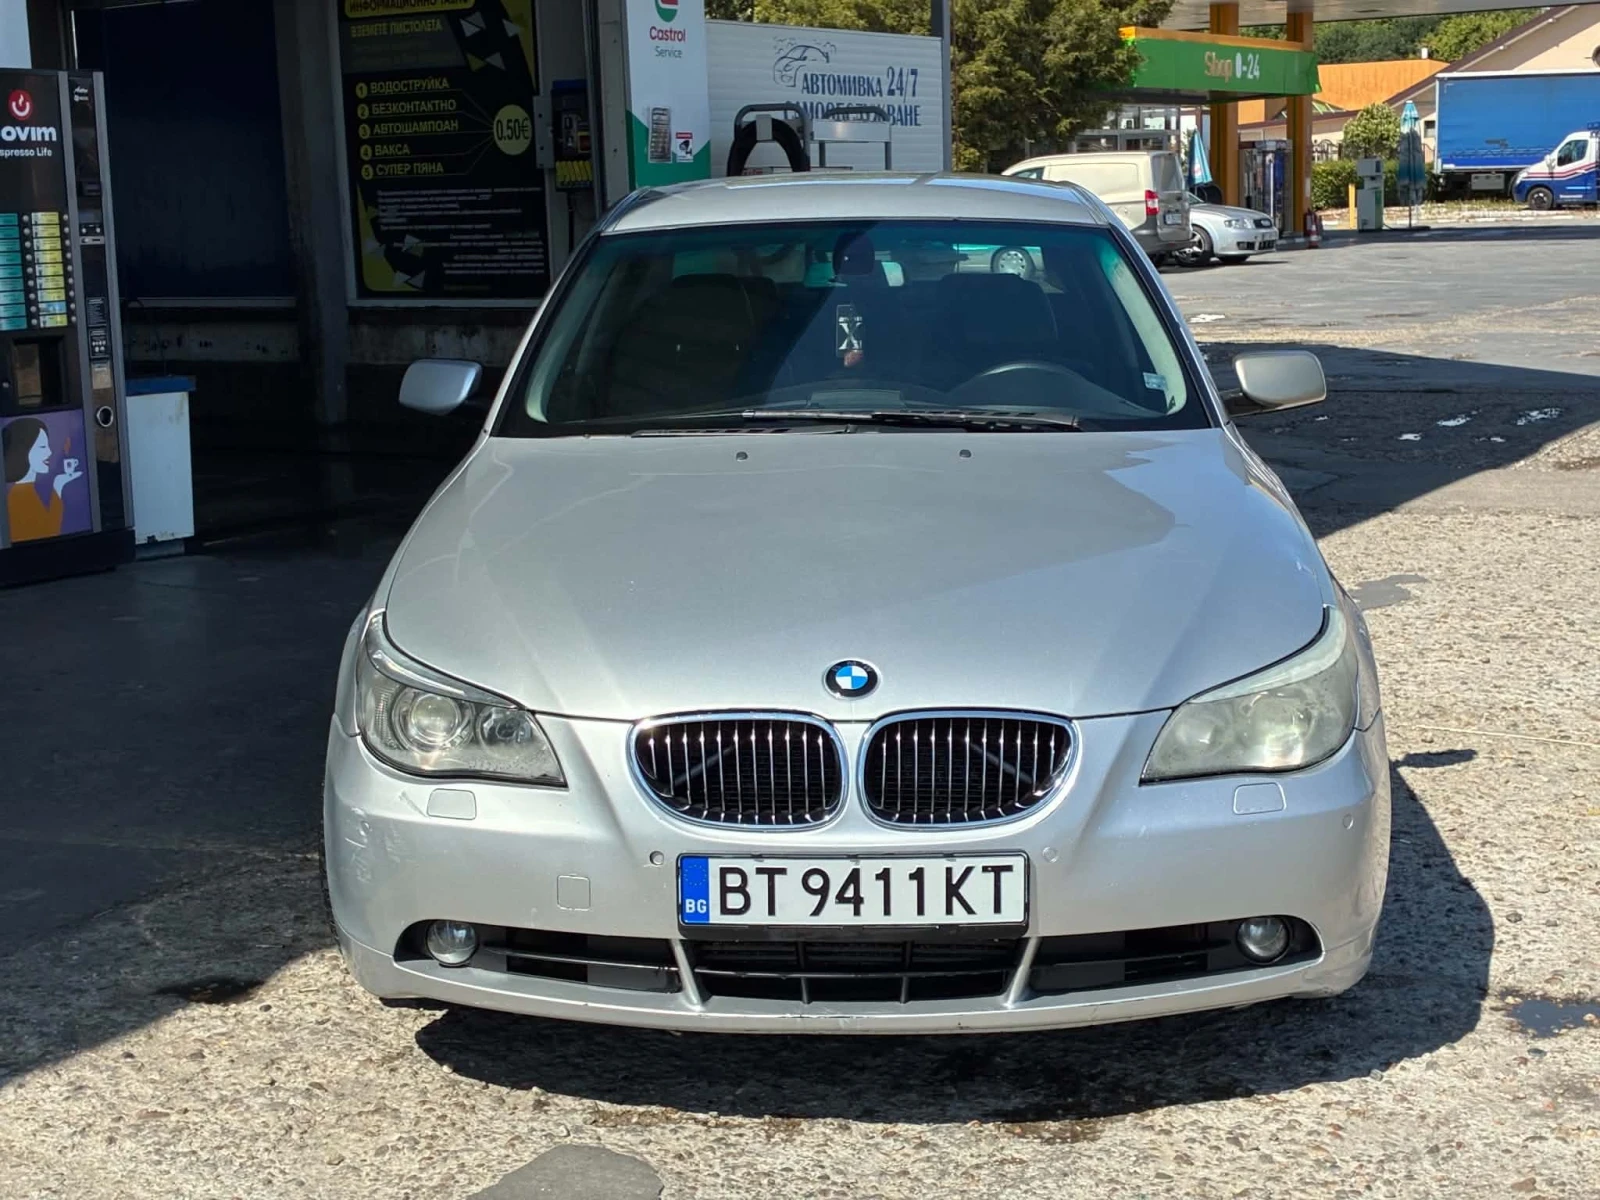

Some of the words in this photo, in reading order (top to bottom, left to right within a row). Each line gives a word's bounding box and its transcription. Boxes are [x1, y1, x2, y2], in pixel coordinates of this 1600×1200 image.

[390, 20, 443, 35] ПИСТОЛЕТА
[649, 26, 686, 43] Castrol
[654, 45, 684, 58] Service
[1204, 51, 1232, 84] Shop
[1235, 52, 1260, 79] 0-24
[370, 77, 450, 95] ВОДОСТРУЙКА
[802, 73, 883, 97] АВТОМИВКА
[887, 66, 918, 103] 24/7
[371, 99, 457, 115] БЕЗКОНТАКТНО
[373, 119, 459, 135] АВТОШАМПОАН
[496, 117, 529, 141] 0.50€
[36, 146, 53, 157] Life
[374, 144, 411, 157] ВАКСА
[376, 163, 411, 176] СУПЕР
[413, 162, 445, 175] ПЯНА
[718, 866, 787, 917] BT
[801, 867, 925, 917] 9411
[944, 864, 1014, 916] KT
[685, 898, 708, 914] BG
